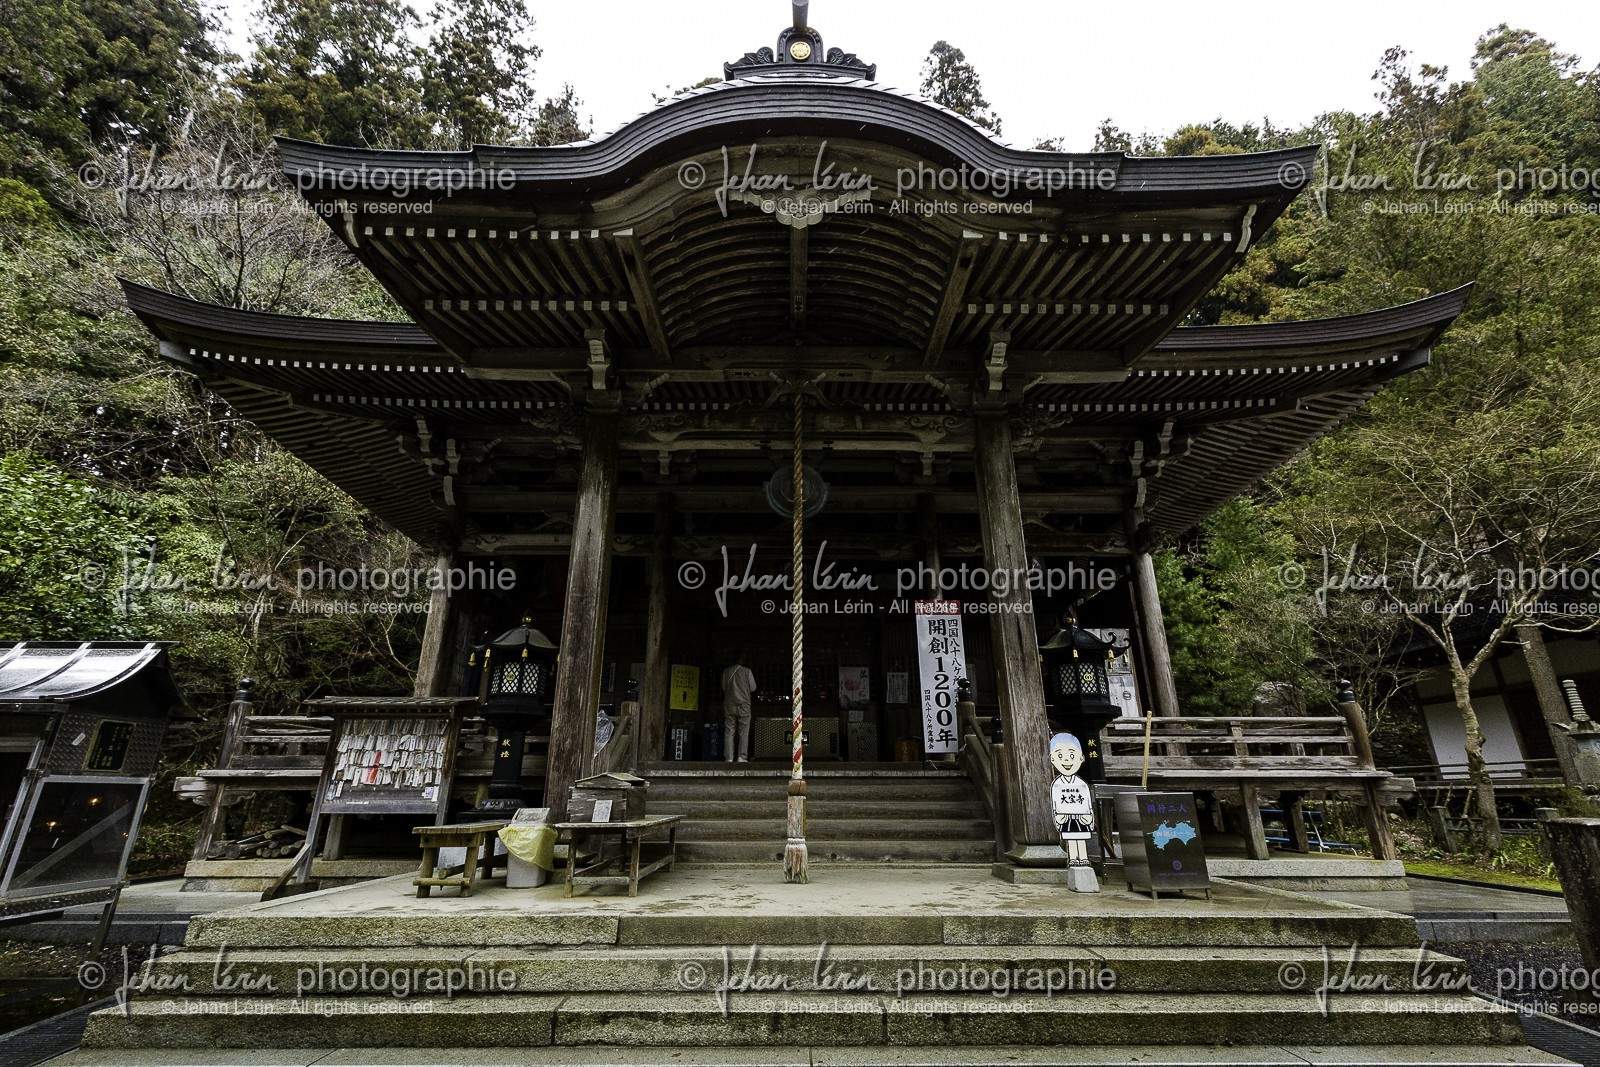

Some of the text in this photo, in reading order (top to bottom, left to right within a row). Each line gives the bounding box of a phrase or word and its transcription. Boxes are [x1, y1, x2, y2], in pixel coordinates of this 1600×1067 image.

[928, 618, 957, 748] 開創1200年
[1060, 793, 1085, 805] 大宝寺
